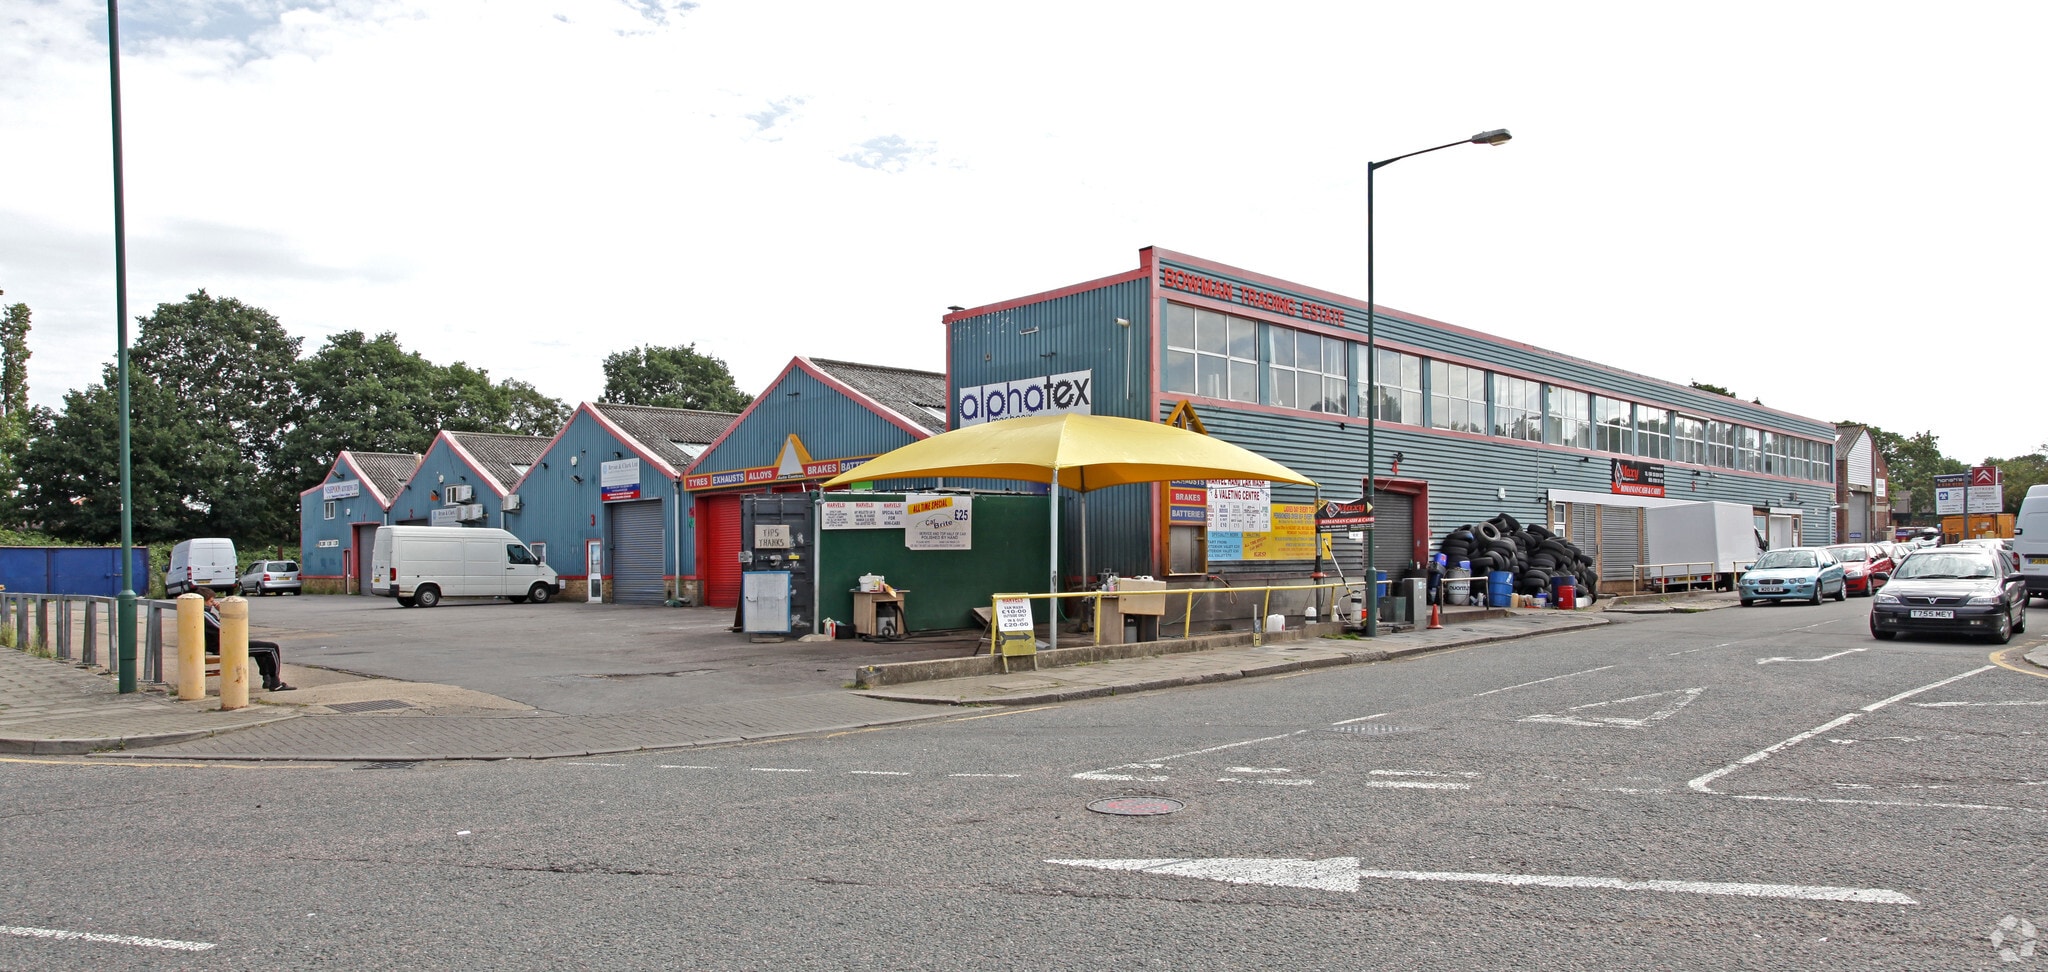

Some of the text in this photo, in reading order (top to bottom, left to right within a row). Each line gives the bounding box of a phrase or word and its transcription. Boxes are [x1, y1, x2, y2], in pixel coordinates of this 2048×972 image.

[1163, 267, 1345, 327] BOWMAN TRADING ESTATE
[960, 375, 1090, 422] alphatex
[807, 463, 837, 475] BRAKES
[712, 473, 744, 484] EXHAUSTS
[748, 470, 772, 480] ALLOYS
[688, 477, 708, 487] TYRES
[1175, 493, 1201, 502] BRAKES
[1214, 490, 1260, 501] & VALETING CENTRE
[913, 498, 948, 513] ALL TIME SPECIAL
[954, 509, 968, 521] £25
[1171, 509, 1205, 518] BATTERIES
[590, 513, 596, 527] 3
[933, 520, 953, 529] Brite
[762, 529, 780, 537] TIPS
[759, 538, 785, 547] THANKS
